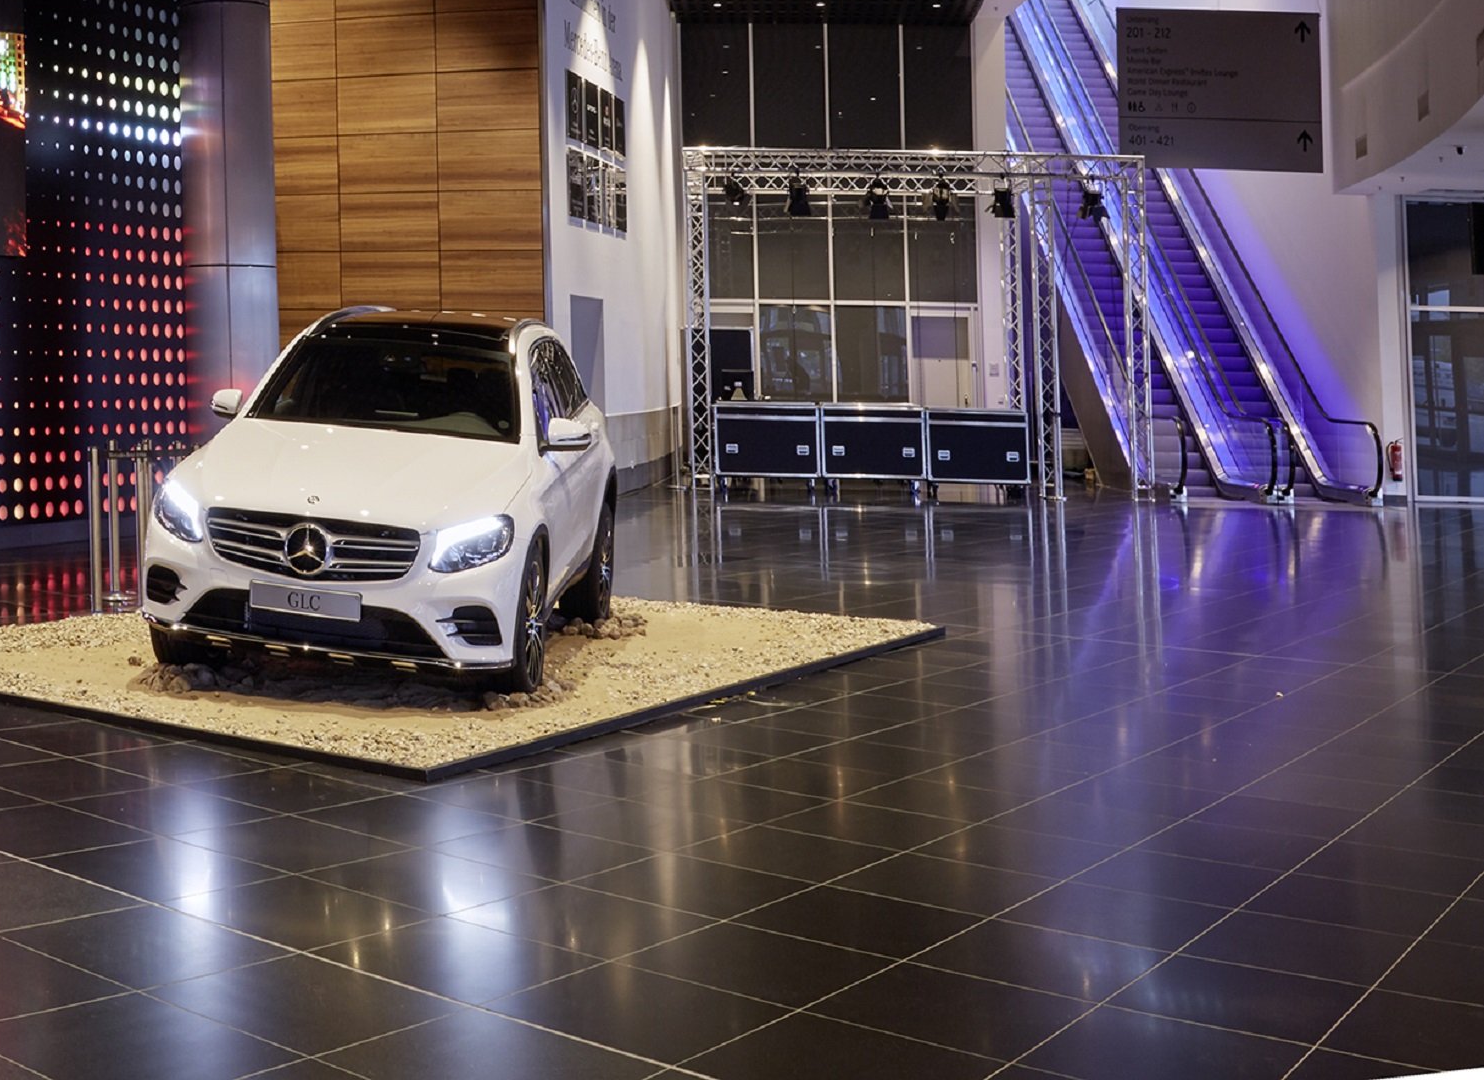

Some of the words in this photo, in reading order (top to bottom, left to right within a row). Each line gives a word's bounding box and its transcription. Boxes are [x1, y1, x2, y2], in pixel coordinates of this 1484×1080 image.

[1126, 26, 1144, 38] 201
[1154, 27, 1172, 39] 212
[1213, 67, 1238, 79] Lounge
[1149, 88, 1162, 98] Day
[1163, 89, 1188, 98] Lounge
[1129, 134, 1146, 146] 401
[1156, 135, 1174, 146] 421
[287, 591, 321, 611] GLC
